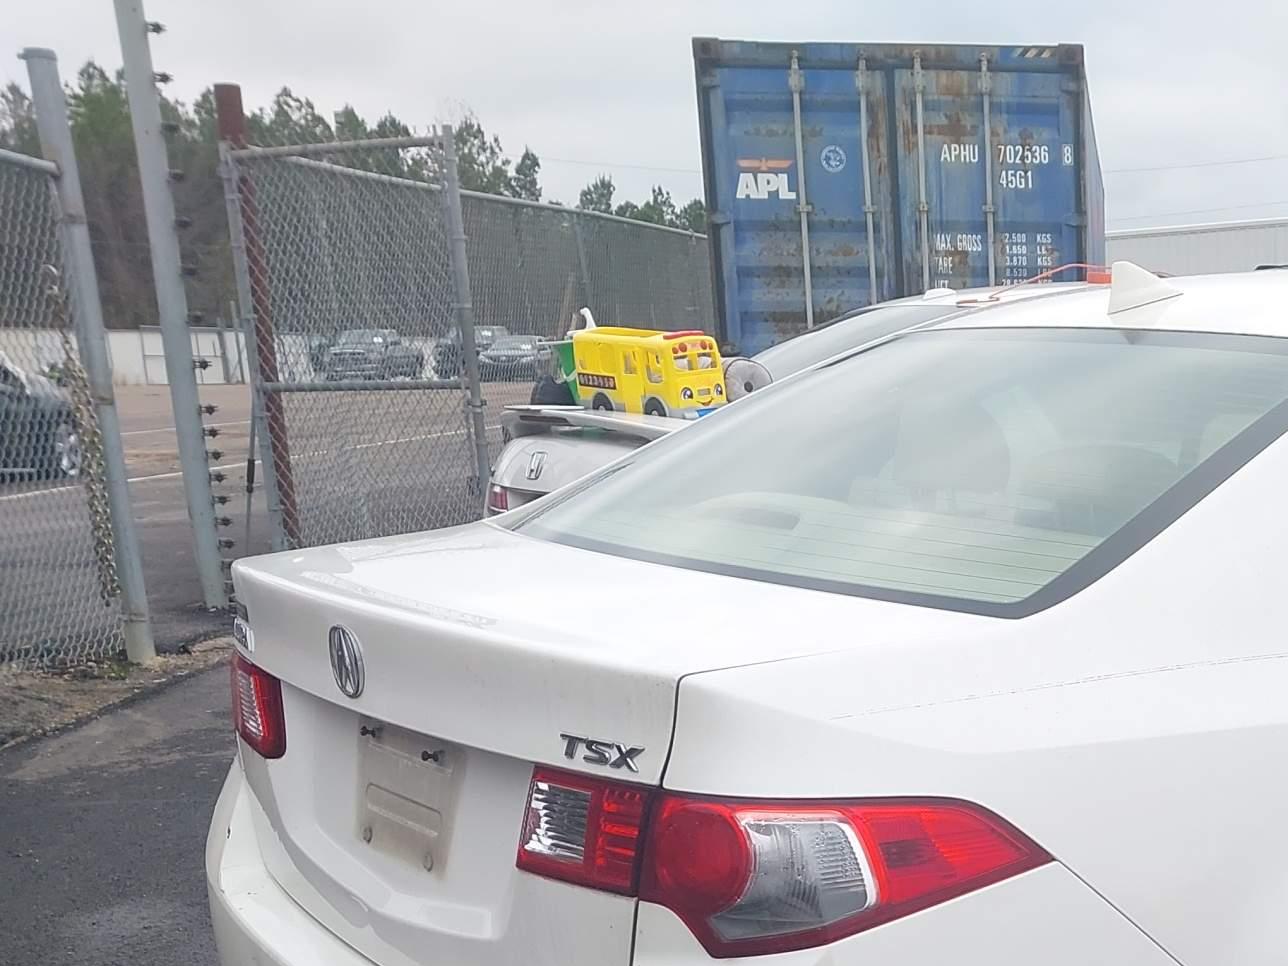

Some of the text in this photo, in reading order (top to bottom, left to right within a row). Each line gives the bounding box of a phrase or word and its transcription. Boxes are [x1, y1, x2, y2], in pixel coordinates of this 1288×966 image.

[940, 143, 979, 162] APHU
[1063, 145, 1072, 164] 8
[736, 173, 797, 200] APL
[999, 170, 1033, 189] 45G1
[957, 233, 982, 252] GROSS
[1004, 232, 1052, 243] 2.500 KGS
[934, 256, 953, 274] TARE
[1037, 256, 1052, 266] KGS
[560, 732, 646, 774] TSX
